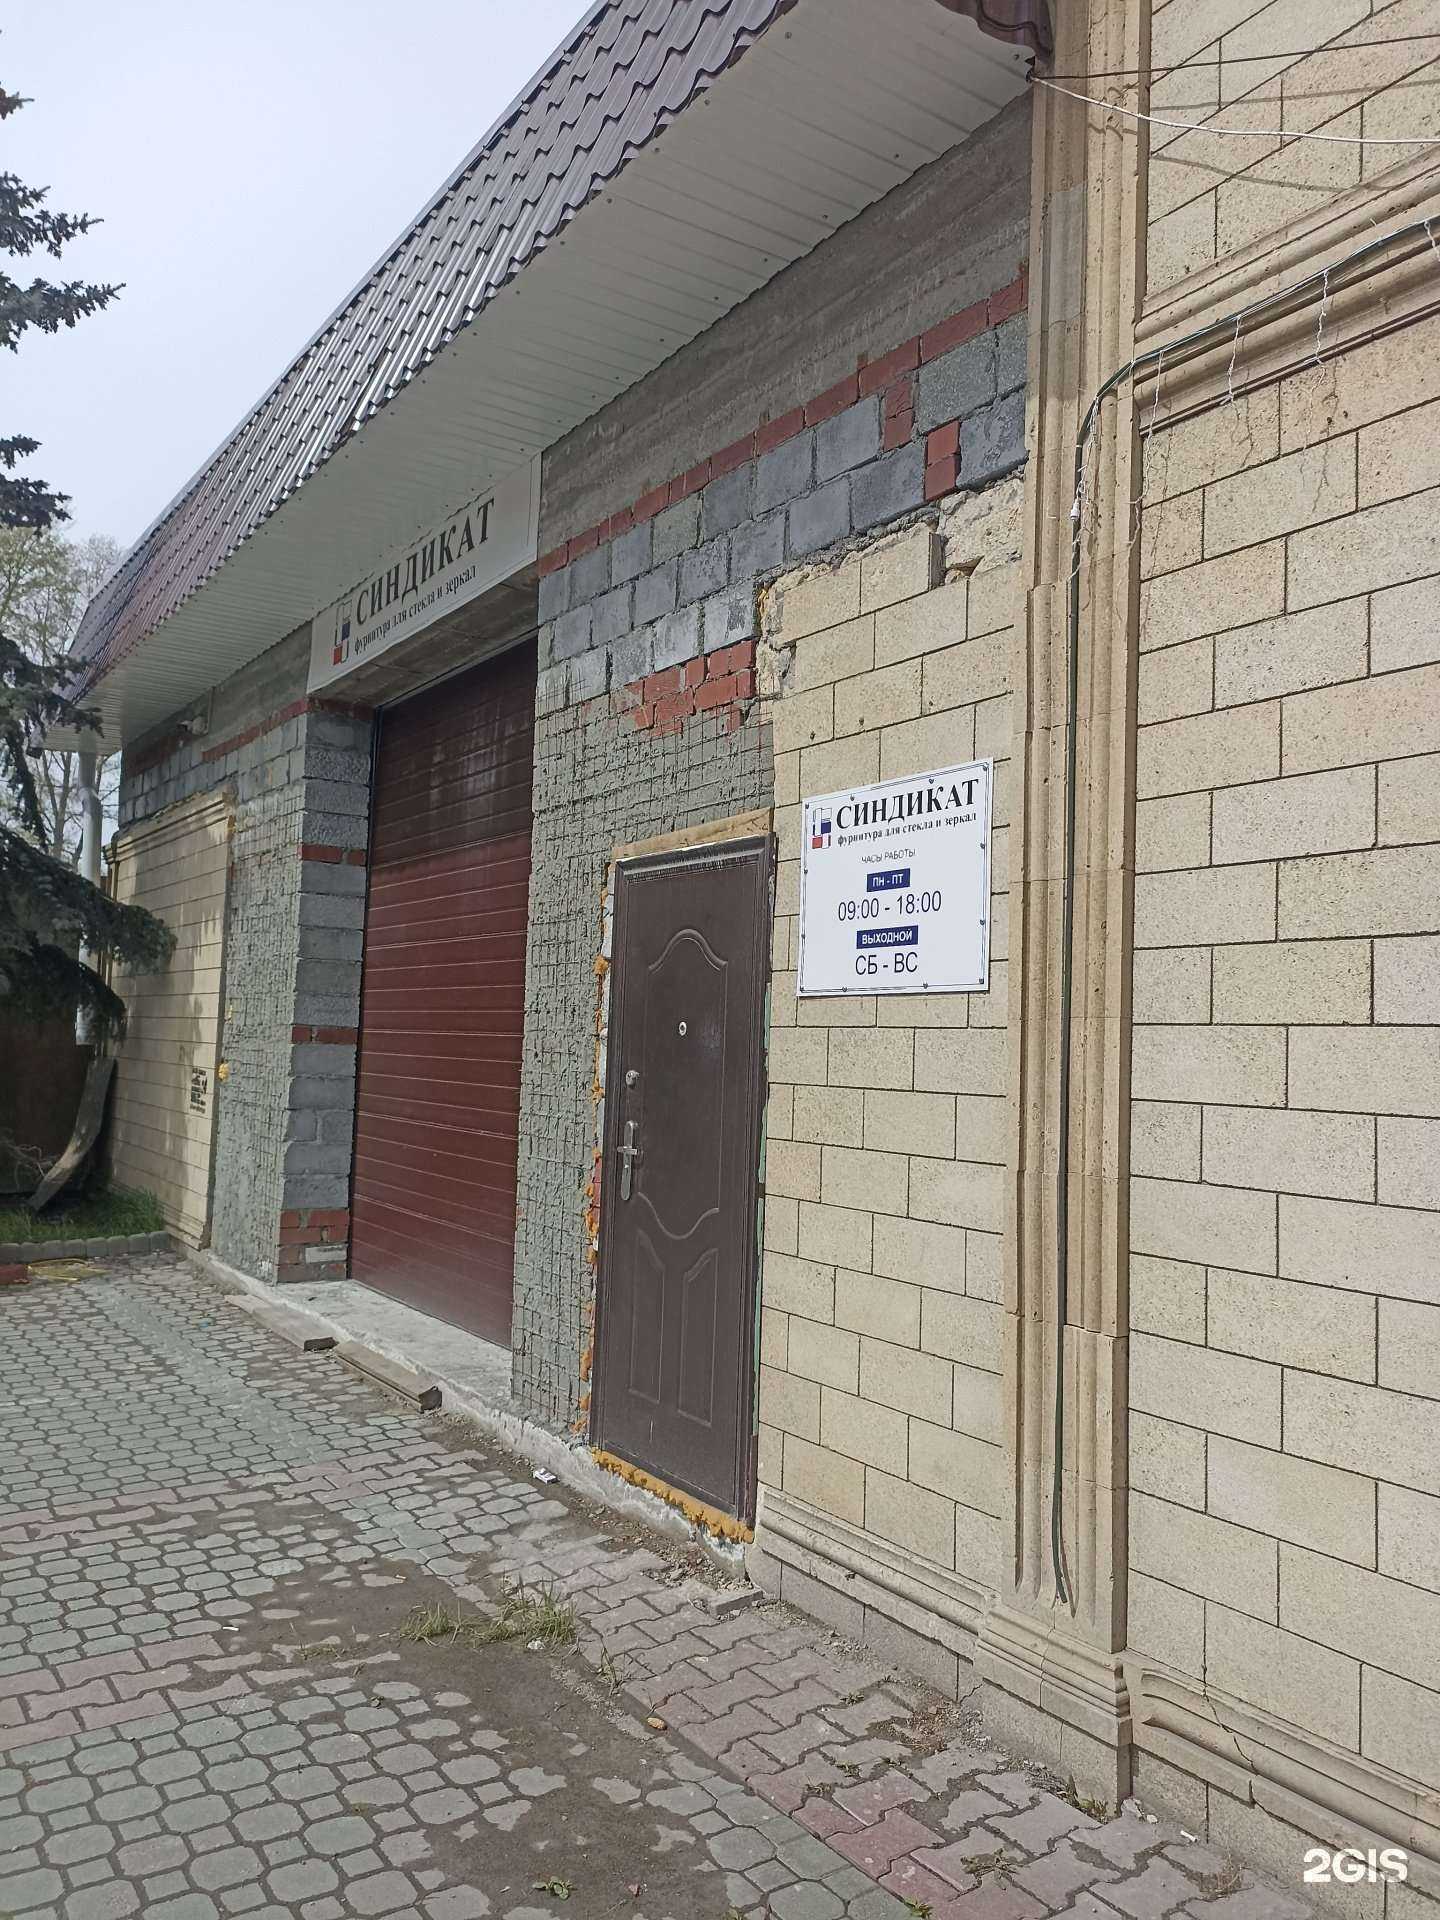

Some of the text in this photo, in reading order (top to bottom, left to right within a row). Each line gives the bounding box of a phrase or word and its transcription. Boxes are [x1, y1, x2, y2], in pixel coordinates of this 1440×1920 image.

[356, 498, 495, 626] СИНДИКАТ
[409, 590, 435, 618] стекла
[437, 584, 443, 599] и
[445, 565, 477, 595] зеркал
[836, 778, 979, 829] СИНДИКАТ
[837, 812, 977, 847] фурнитура для стекла и зеркал
[861, 848, 916, 864] ЧАСЫ РАБОТЫ
[872, 876, 885, 888] ПН
[892, 873, 904, 885] ПТ
[838, 897, 879, 921] 09:00
[896, 890, 942, 915] 18:00
[861, 928, 913, 945] ВЫХОДНОЙ
[855, 954, 878, 975] СБ
[894, 951, 918, 973] ВС
